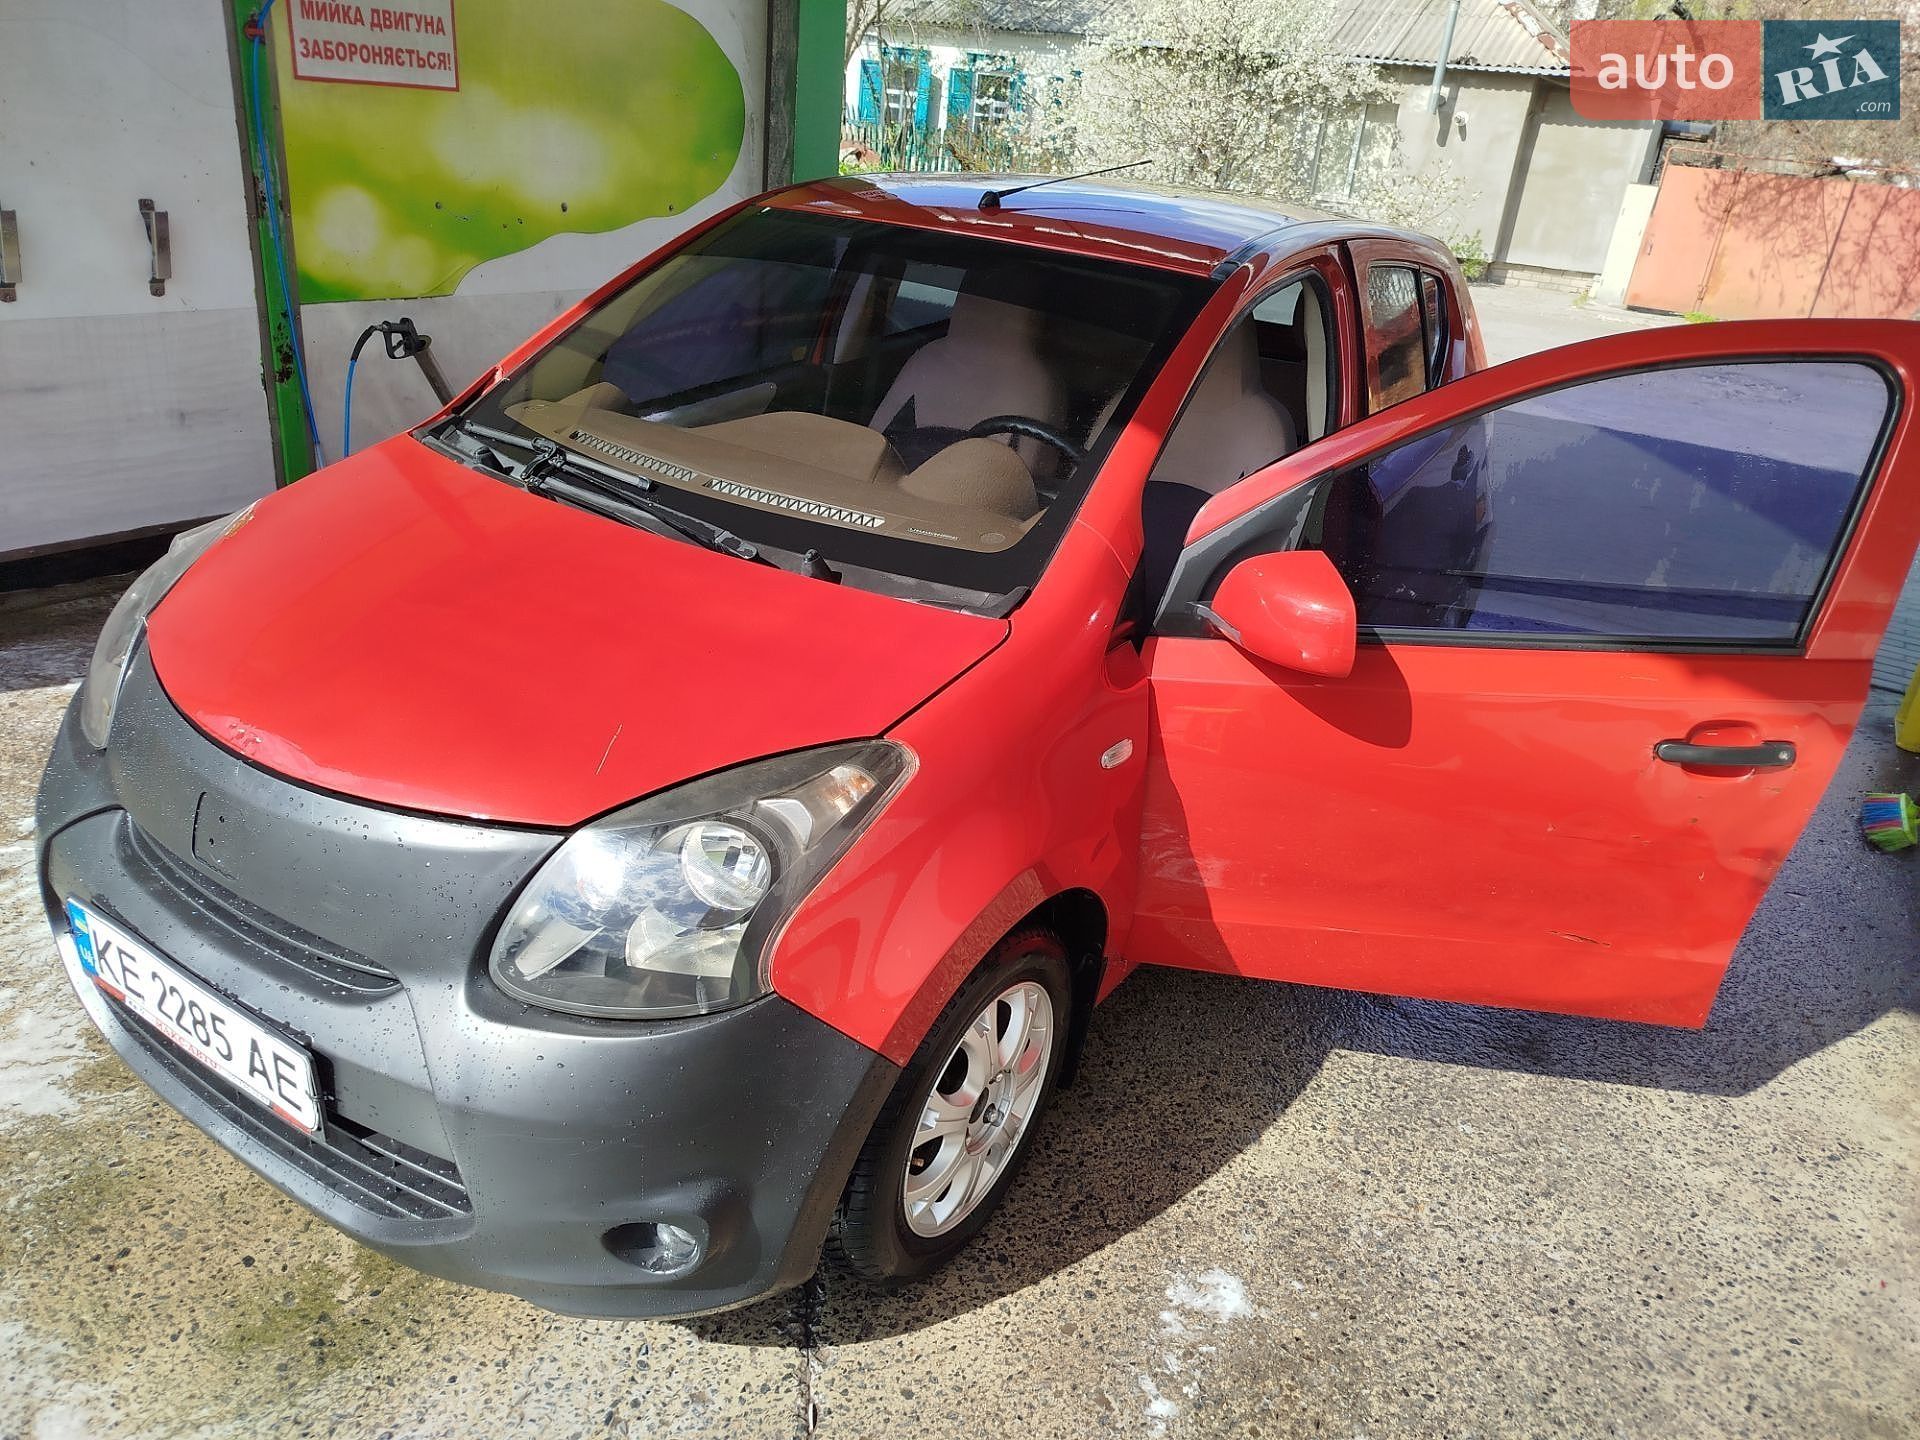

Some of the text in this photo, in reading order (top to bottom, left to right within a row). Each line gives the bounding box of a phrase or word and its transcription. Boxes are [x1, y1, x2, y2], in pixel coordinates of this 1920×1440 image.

[300, 0, 446, 36] МИЙКА ДВИГУНА
[299, 38, 452, 71] ЗАБОРОНЯЄТЬСЯ!
[93, 929, 145, 1001] KE
[151, 970, 233, 1062] 2285
[249, 1037, 302, 1112] AE
